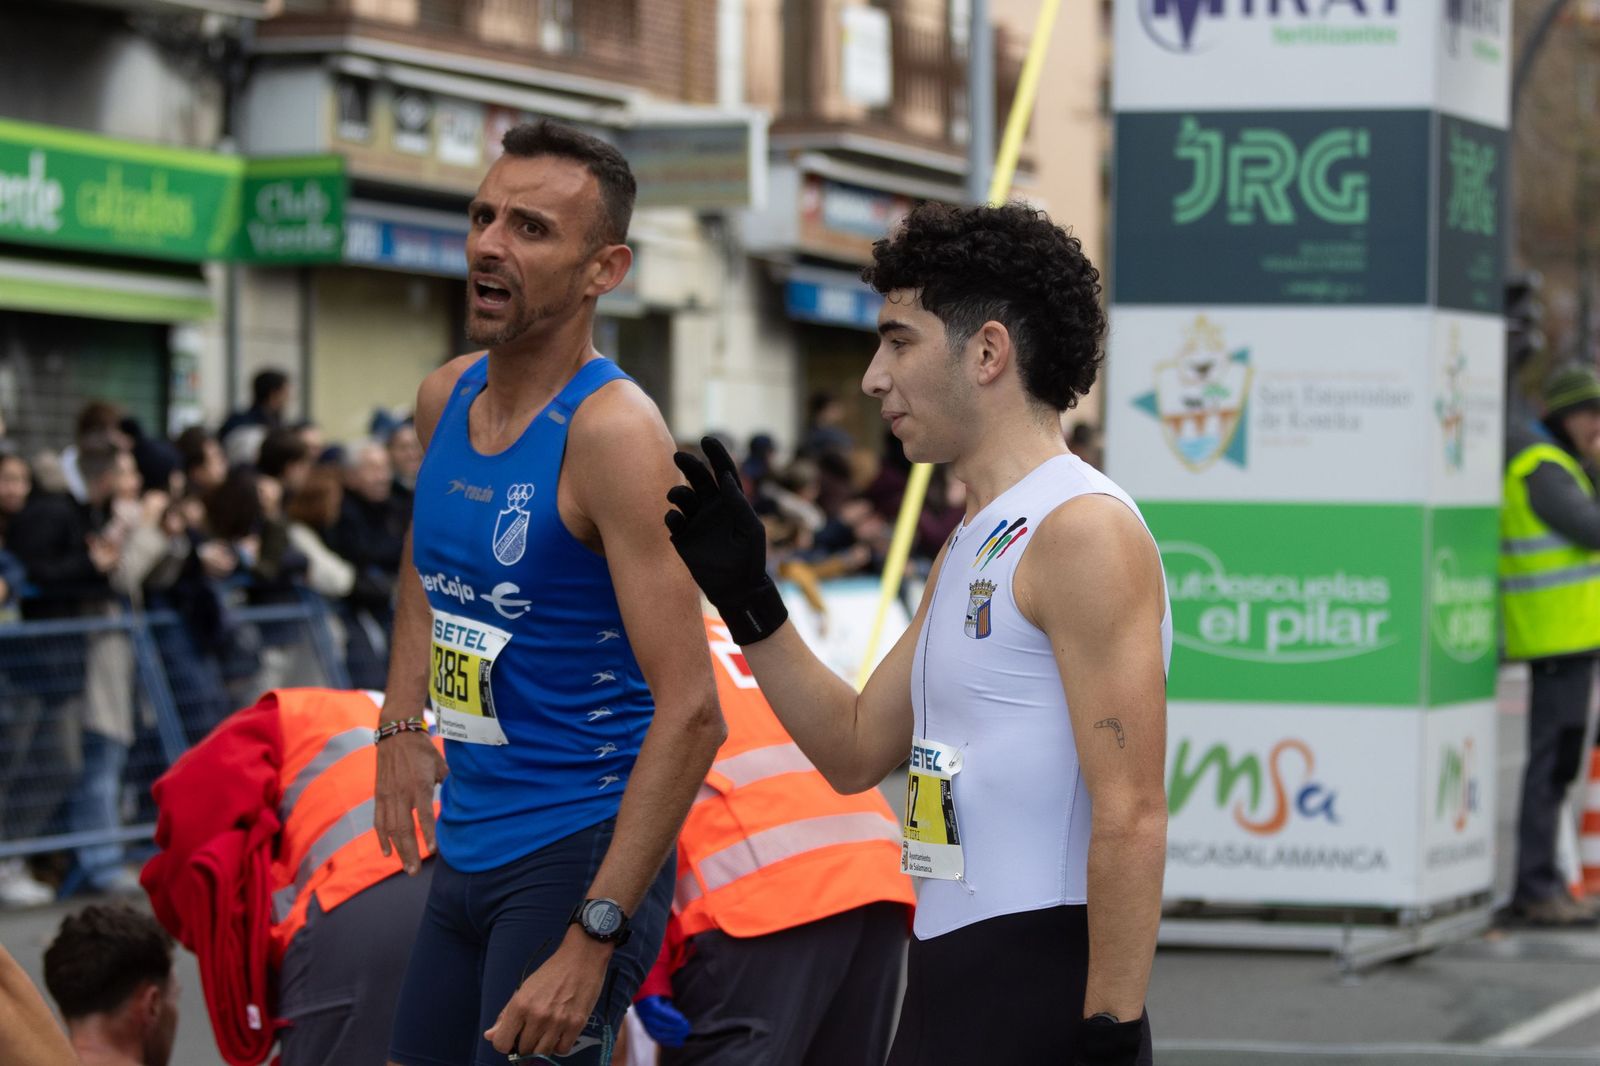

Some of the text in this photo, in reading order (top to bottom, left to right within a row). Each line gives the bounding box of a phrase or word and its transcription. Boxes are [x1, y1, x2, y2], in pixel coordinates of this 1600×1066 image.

[1173, 117, 1370, 224] JRG
[255, 180, 330, 222] Club
[248, 218, 338, 256] Verde
[434, 619, 488, 652] SETEL
[1198, 600, 1250, 644] el
[1266, 599, 1390, 655] pilar
